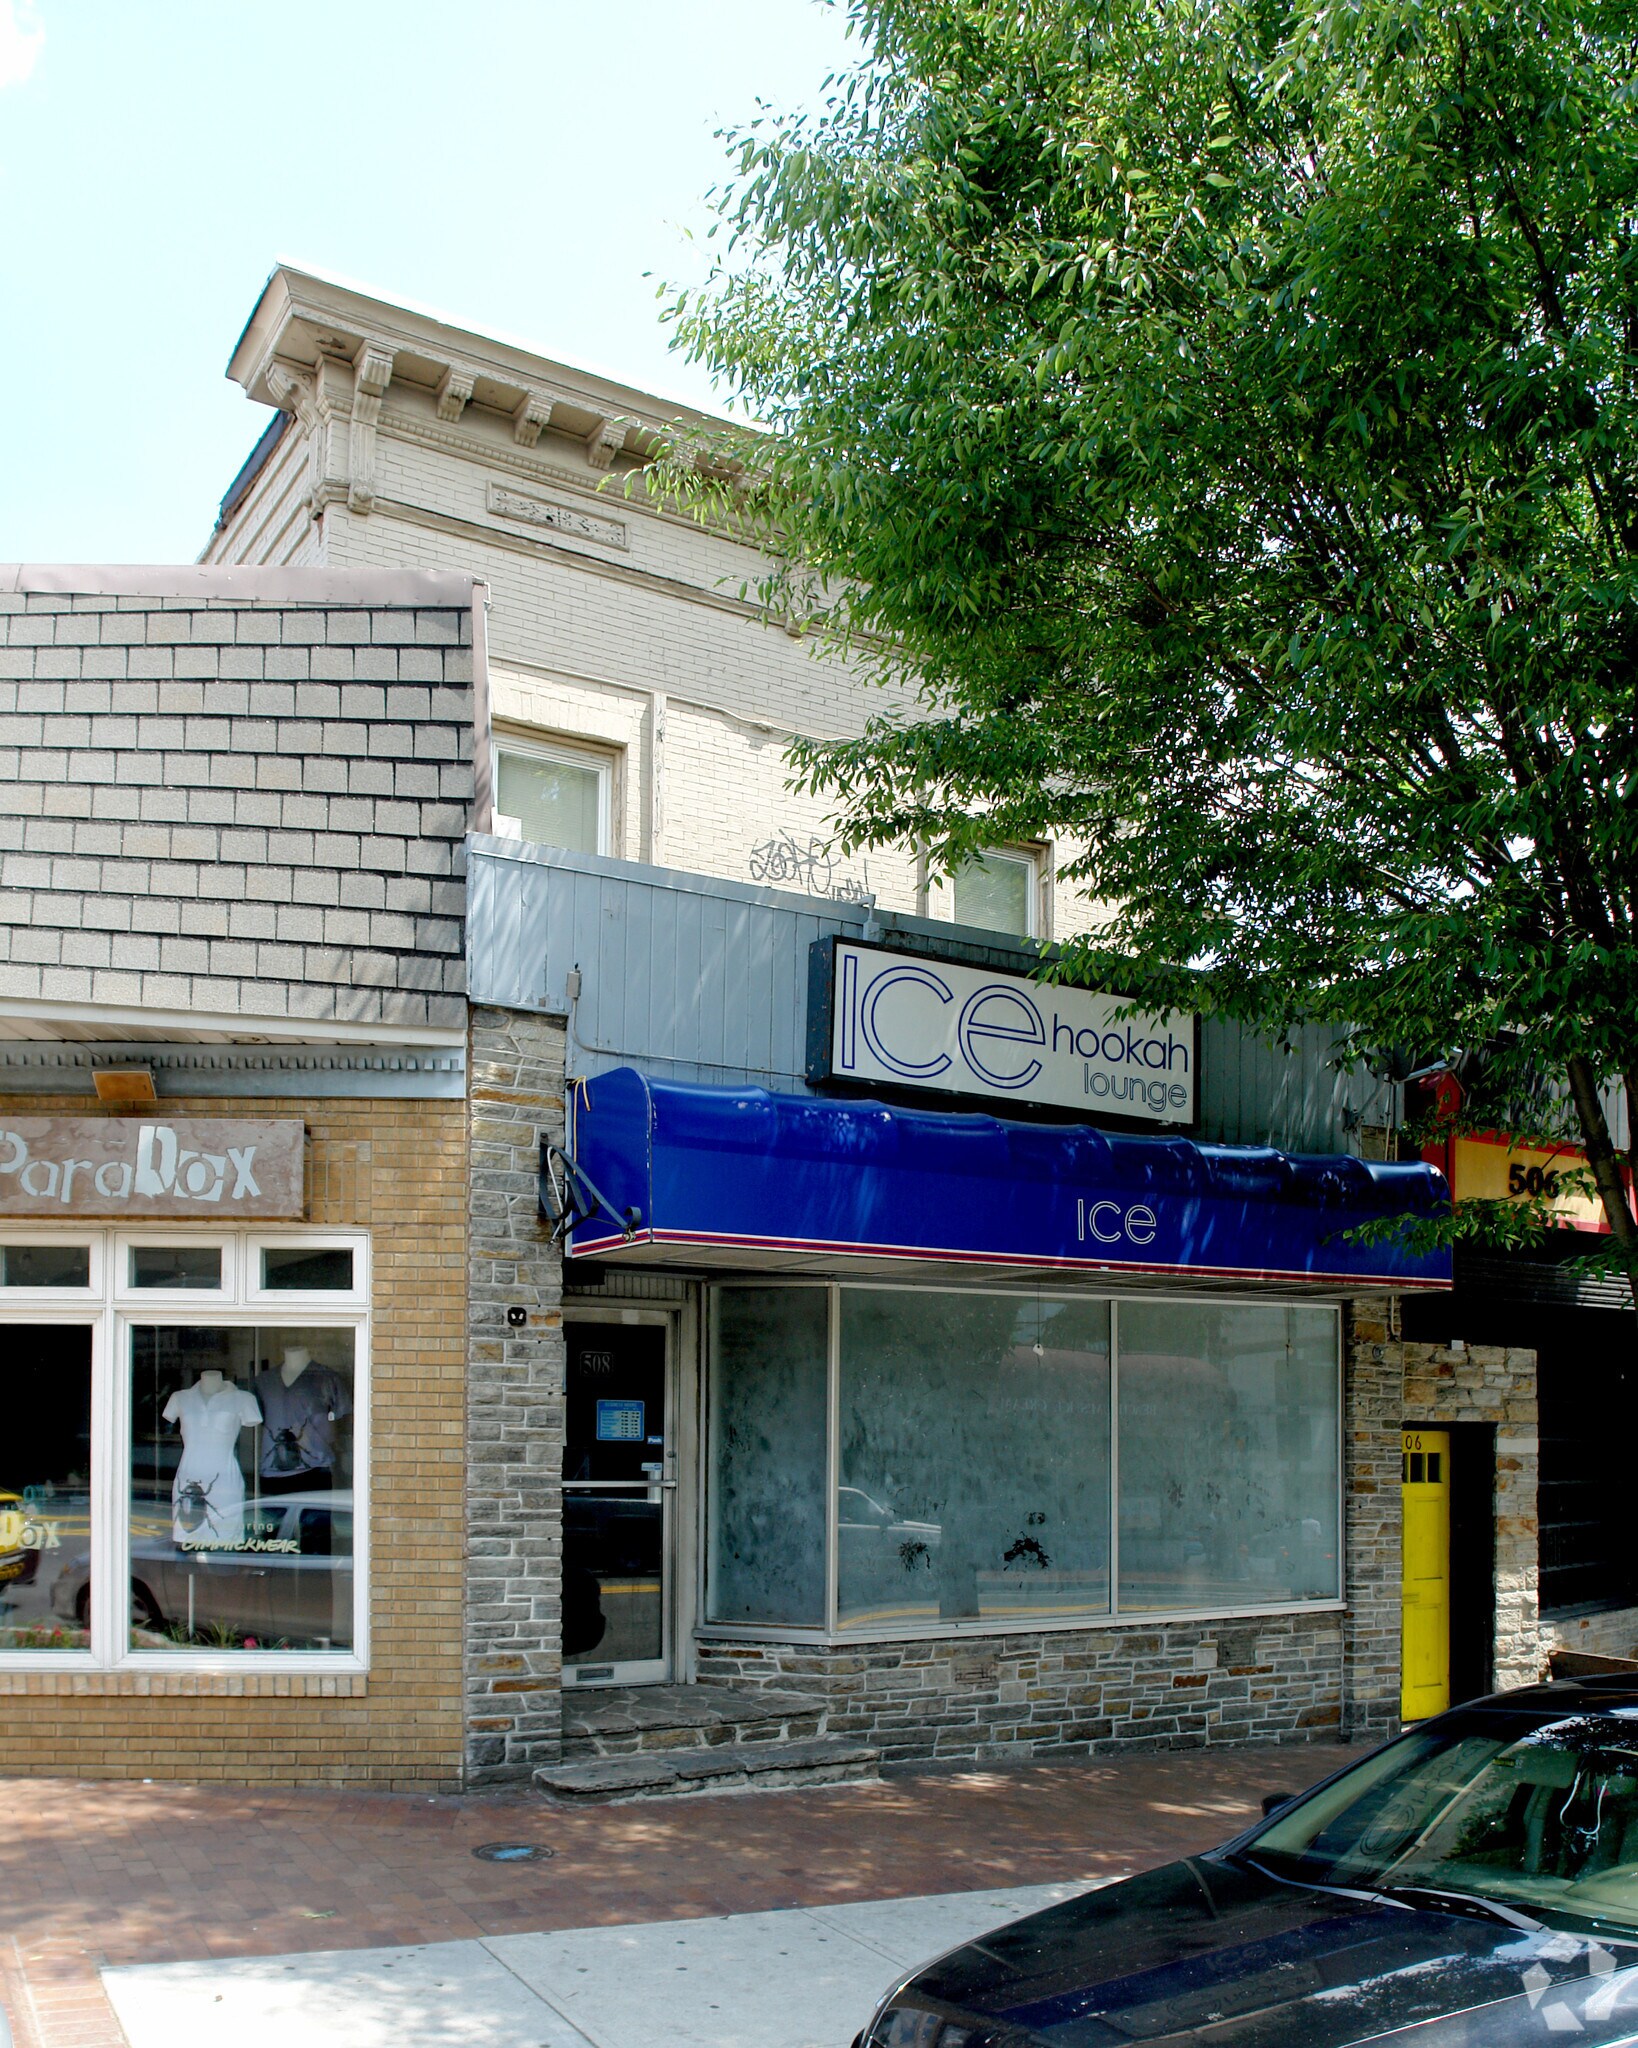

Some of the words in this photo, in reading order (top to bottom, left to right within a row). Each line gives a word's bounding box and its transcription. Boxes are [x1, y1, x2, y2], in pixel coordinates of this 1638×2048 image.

[1052, 1013, 1189, 1072] hookah
[1083, 1063, 1188, 1112] lounge
[1508, 1163, 1560, 1199] 506
[583, 1354, 611, 1374] 508
